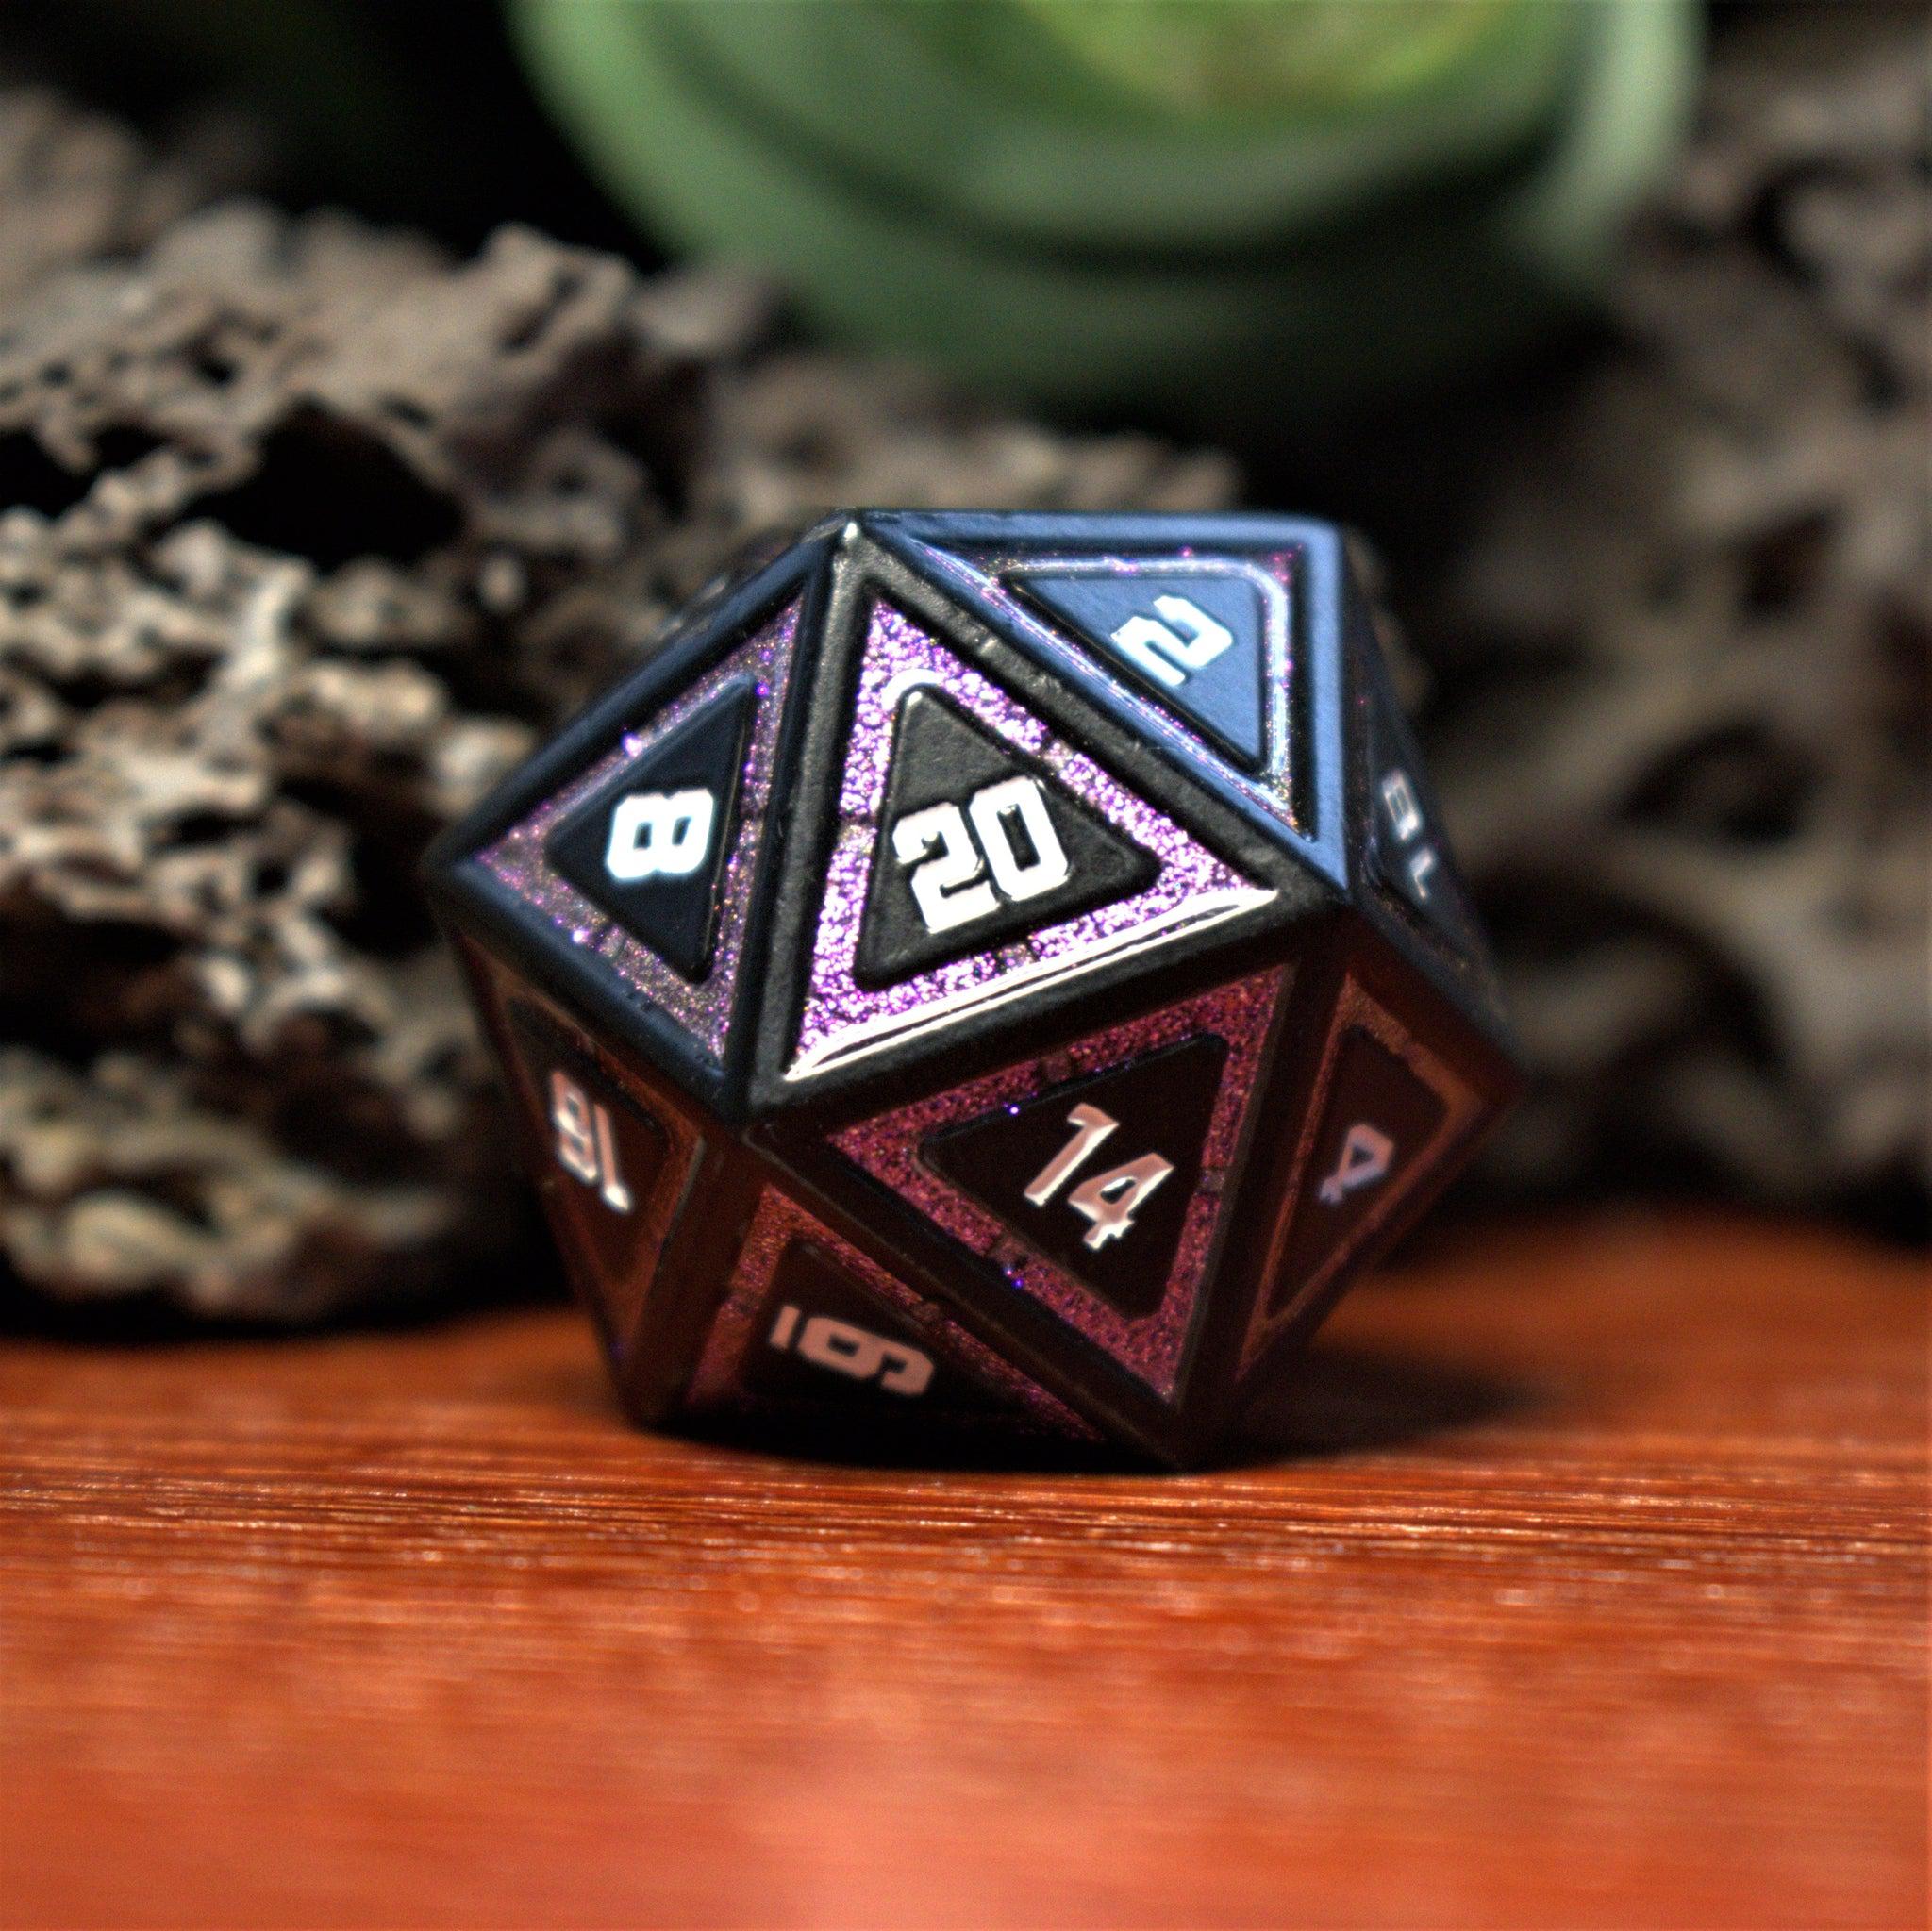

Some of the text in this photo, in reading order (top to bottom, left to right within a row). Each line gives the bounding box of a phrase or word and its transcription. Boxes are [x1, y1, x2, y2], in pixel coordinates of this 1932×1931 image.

[1110, 595, 1232, 688] 2
[605, 788, 715, 882] 8
[892, 776, 1070, 934] 20
[1024, 1104, 1174, 1251] 14
[1319, 1124, 1394, 1204] 4
